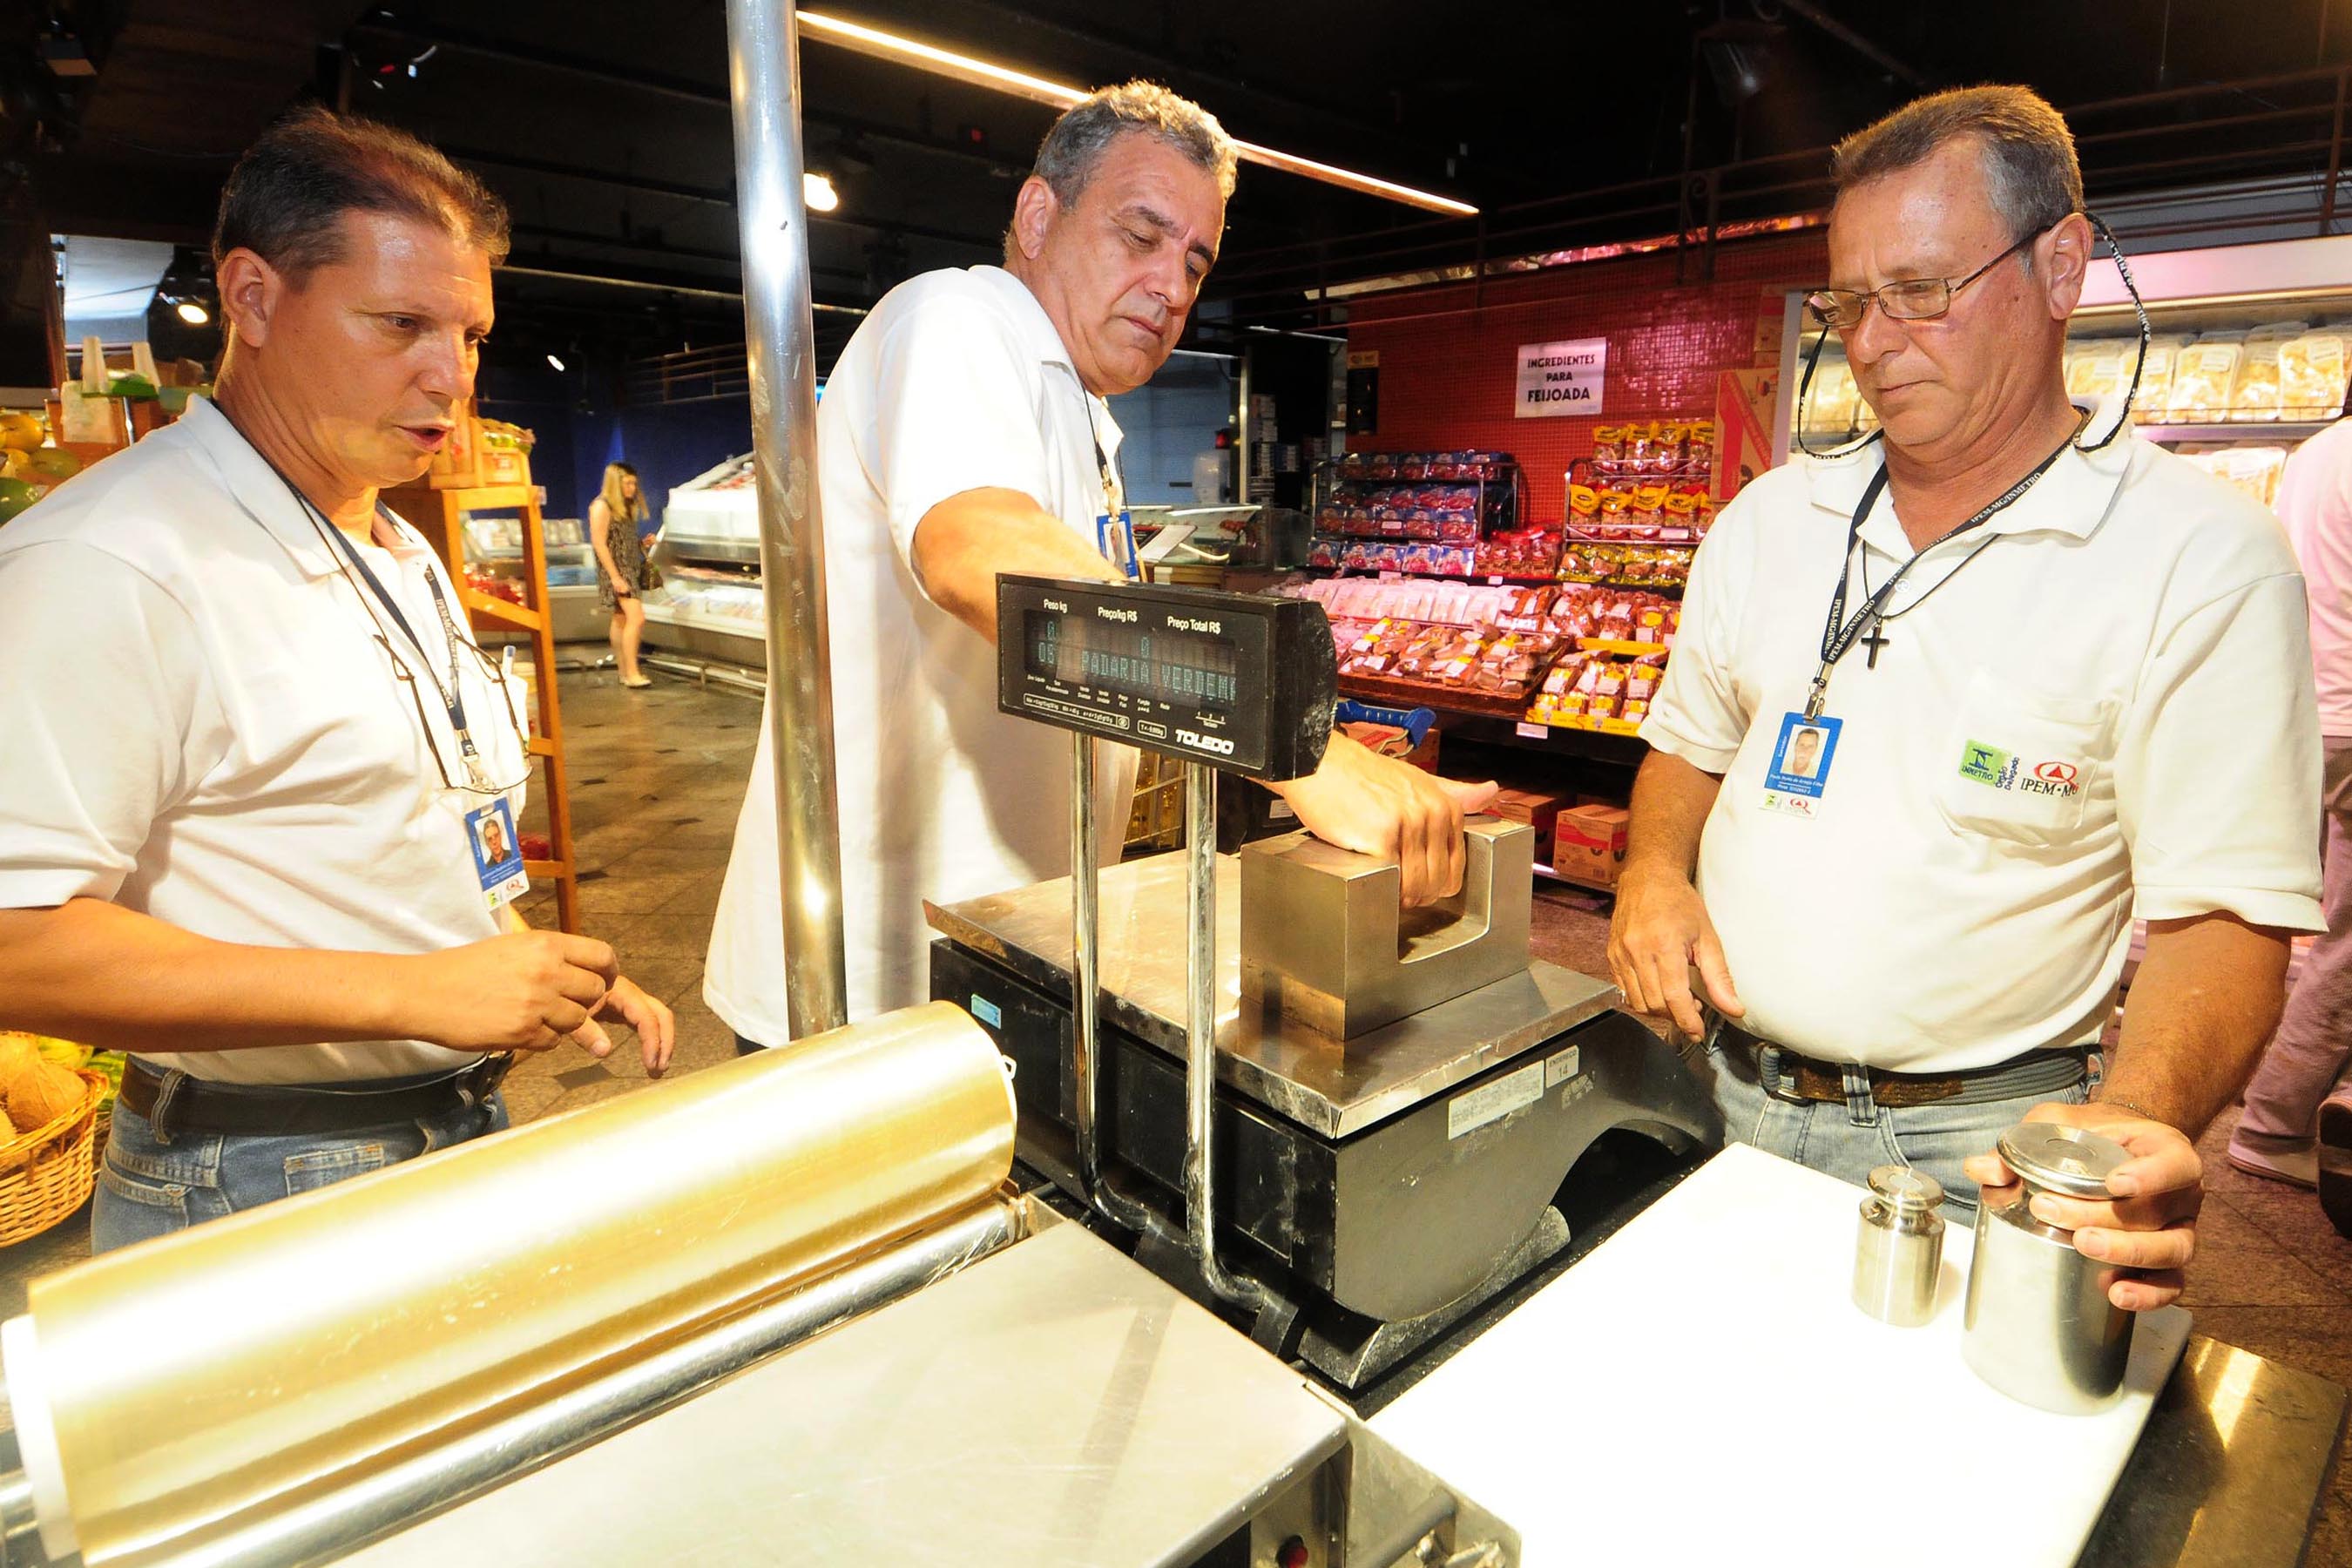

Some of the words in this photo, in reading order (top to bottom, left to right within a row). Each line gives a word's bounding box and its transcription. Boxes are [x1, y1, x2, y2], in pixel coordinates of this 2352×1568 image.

[1527, 354, 1596, 368] INGREDIENTES
[1545, 372, 1573, 382] PARA
[1527, 388, 1591, 402] FEIJOADA
[1970, 472, 2042, 524] IPEM-MG/INMETRO
[1043, 598, 1059, 611] Peso
[1059, 601, 1068, 613] kg
[1098, 606, 1126, 623] Preço/kg
[1126, 610, 1139, 623] R$
[1167, 616, 1190, 632] Preço
[1190, 619, 1209, 632] Total
[1209, 621, 1221, 635] R$
[1828, 599, 1876, 662] IPEM-MG/INMETRO
[1082, 650, 1150, 684] PADARIA
[1175, 728, 1235, 755] TOLEDO
[1558, 1064, 1569, 1078] 14
